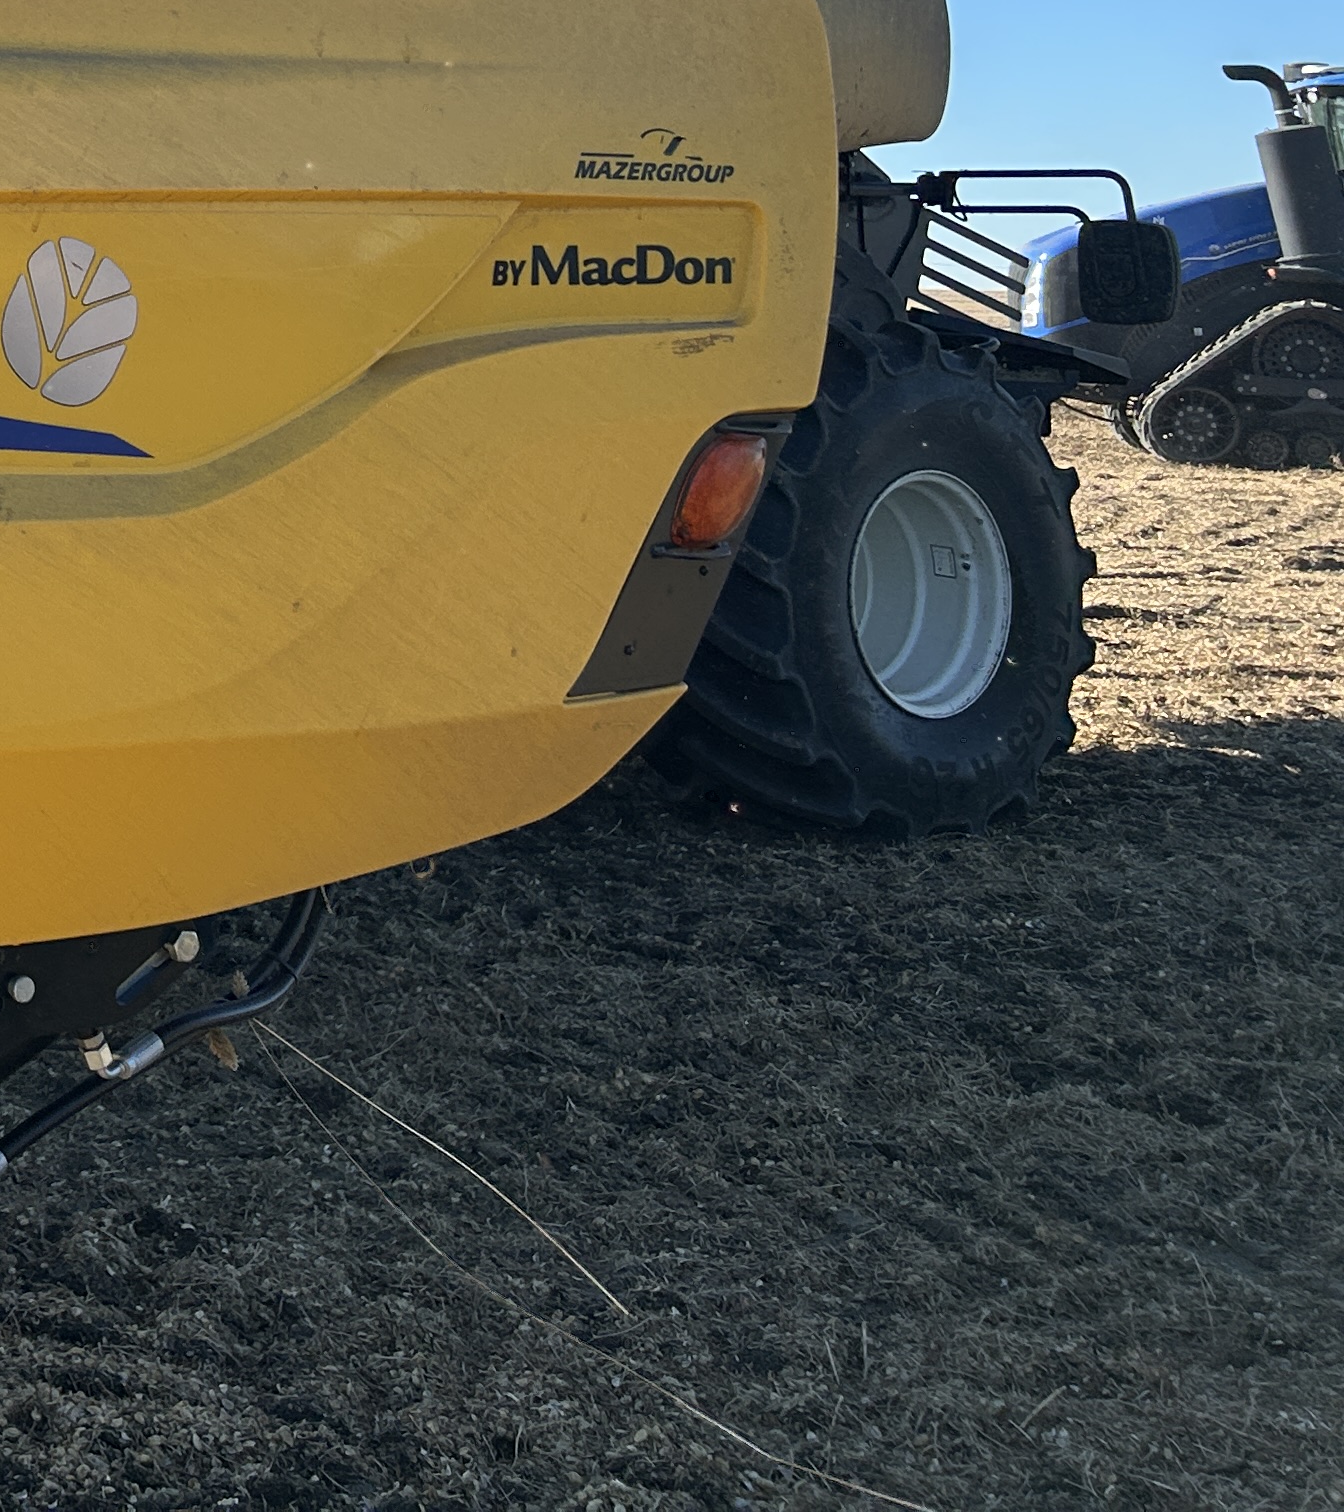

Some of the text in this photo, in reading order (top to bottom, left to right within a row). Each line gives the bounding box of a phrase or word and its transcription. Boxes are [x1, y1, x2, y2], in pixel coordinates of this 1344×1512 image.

[574, 160, 735, 184] MAZERGROUP
[491, 244, 735, 286] BY MacDon
